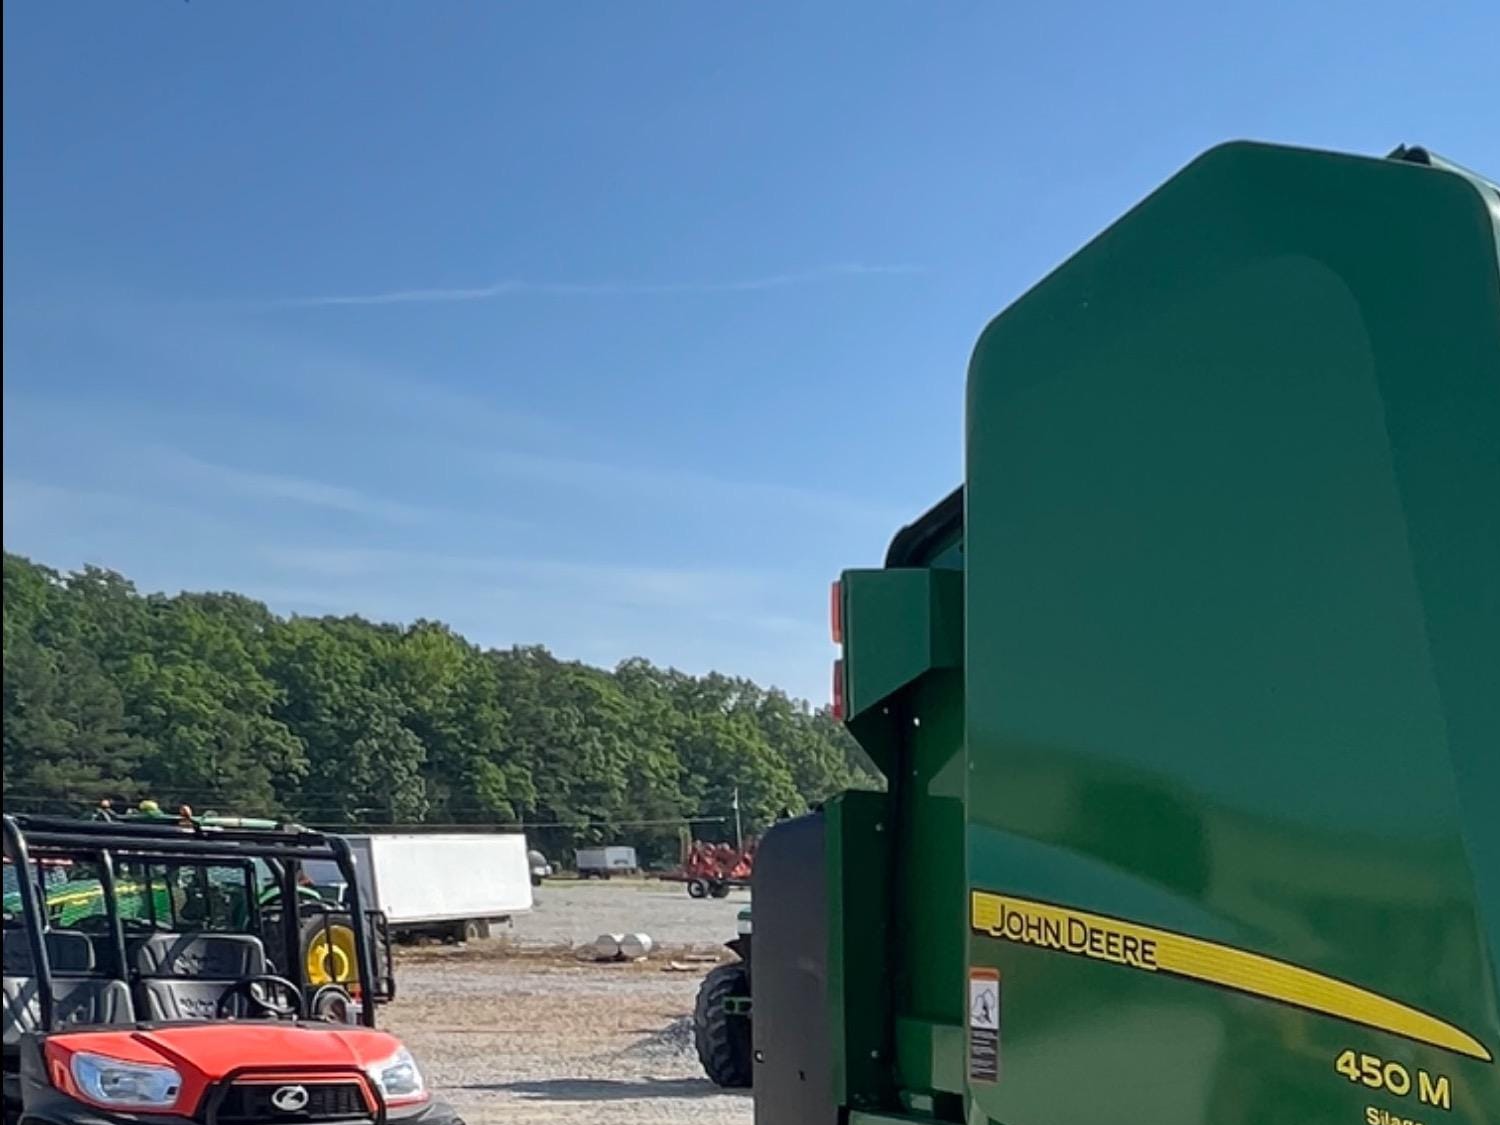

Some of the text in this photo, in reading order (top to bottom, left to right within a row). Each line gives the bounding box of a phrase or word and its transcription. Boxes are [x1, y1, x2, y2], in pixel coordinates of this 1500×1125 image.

[992, 903, 1157, 966] JOHN DEERE
[1335, 1050, 1451, 1110] 450 M
